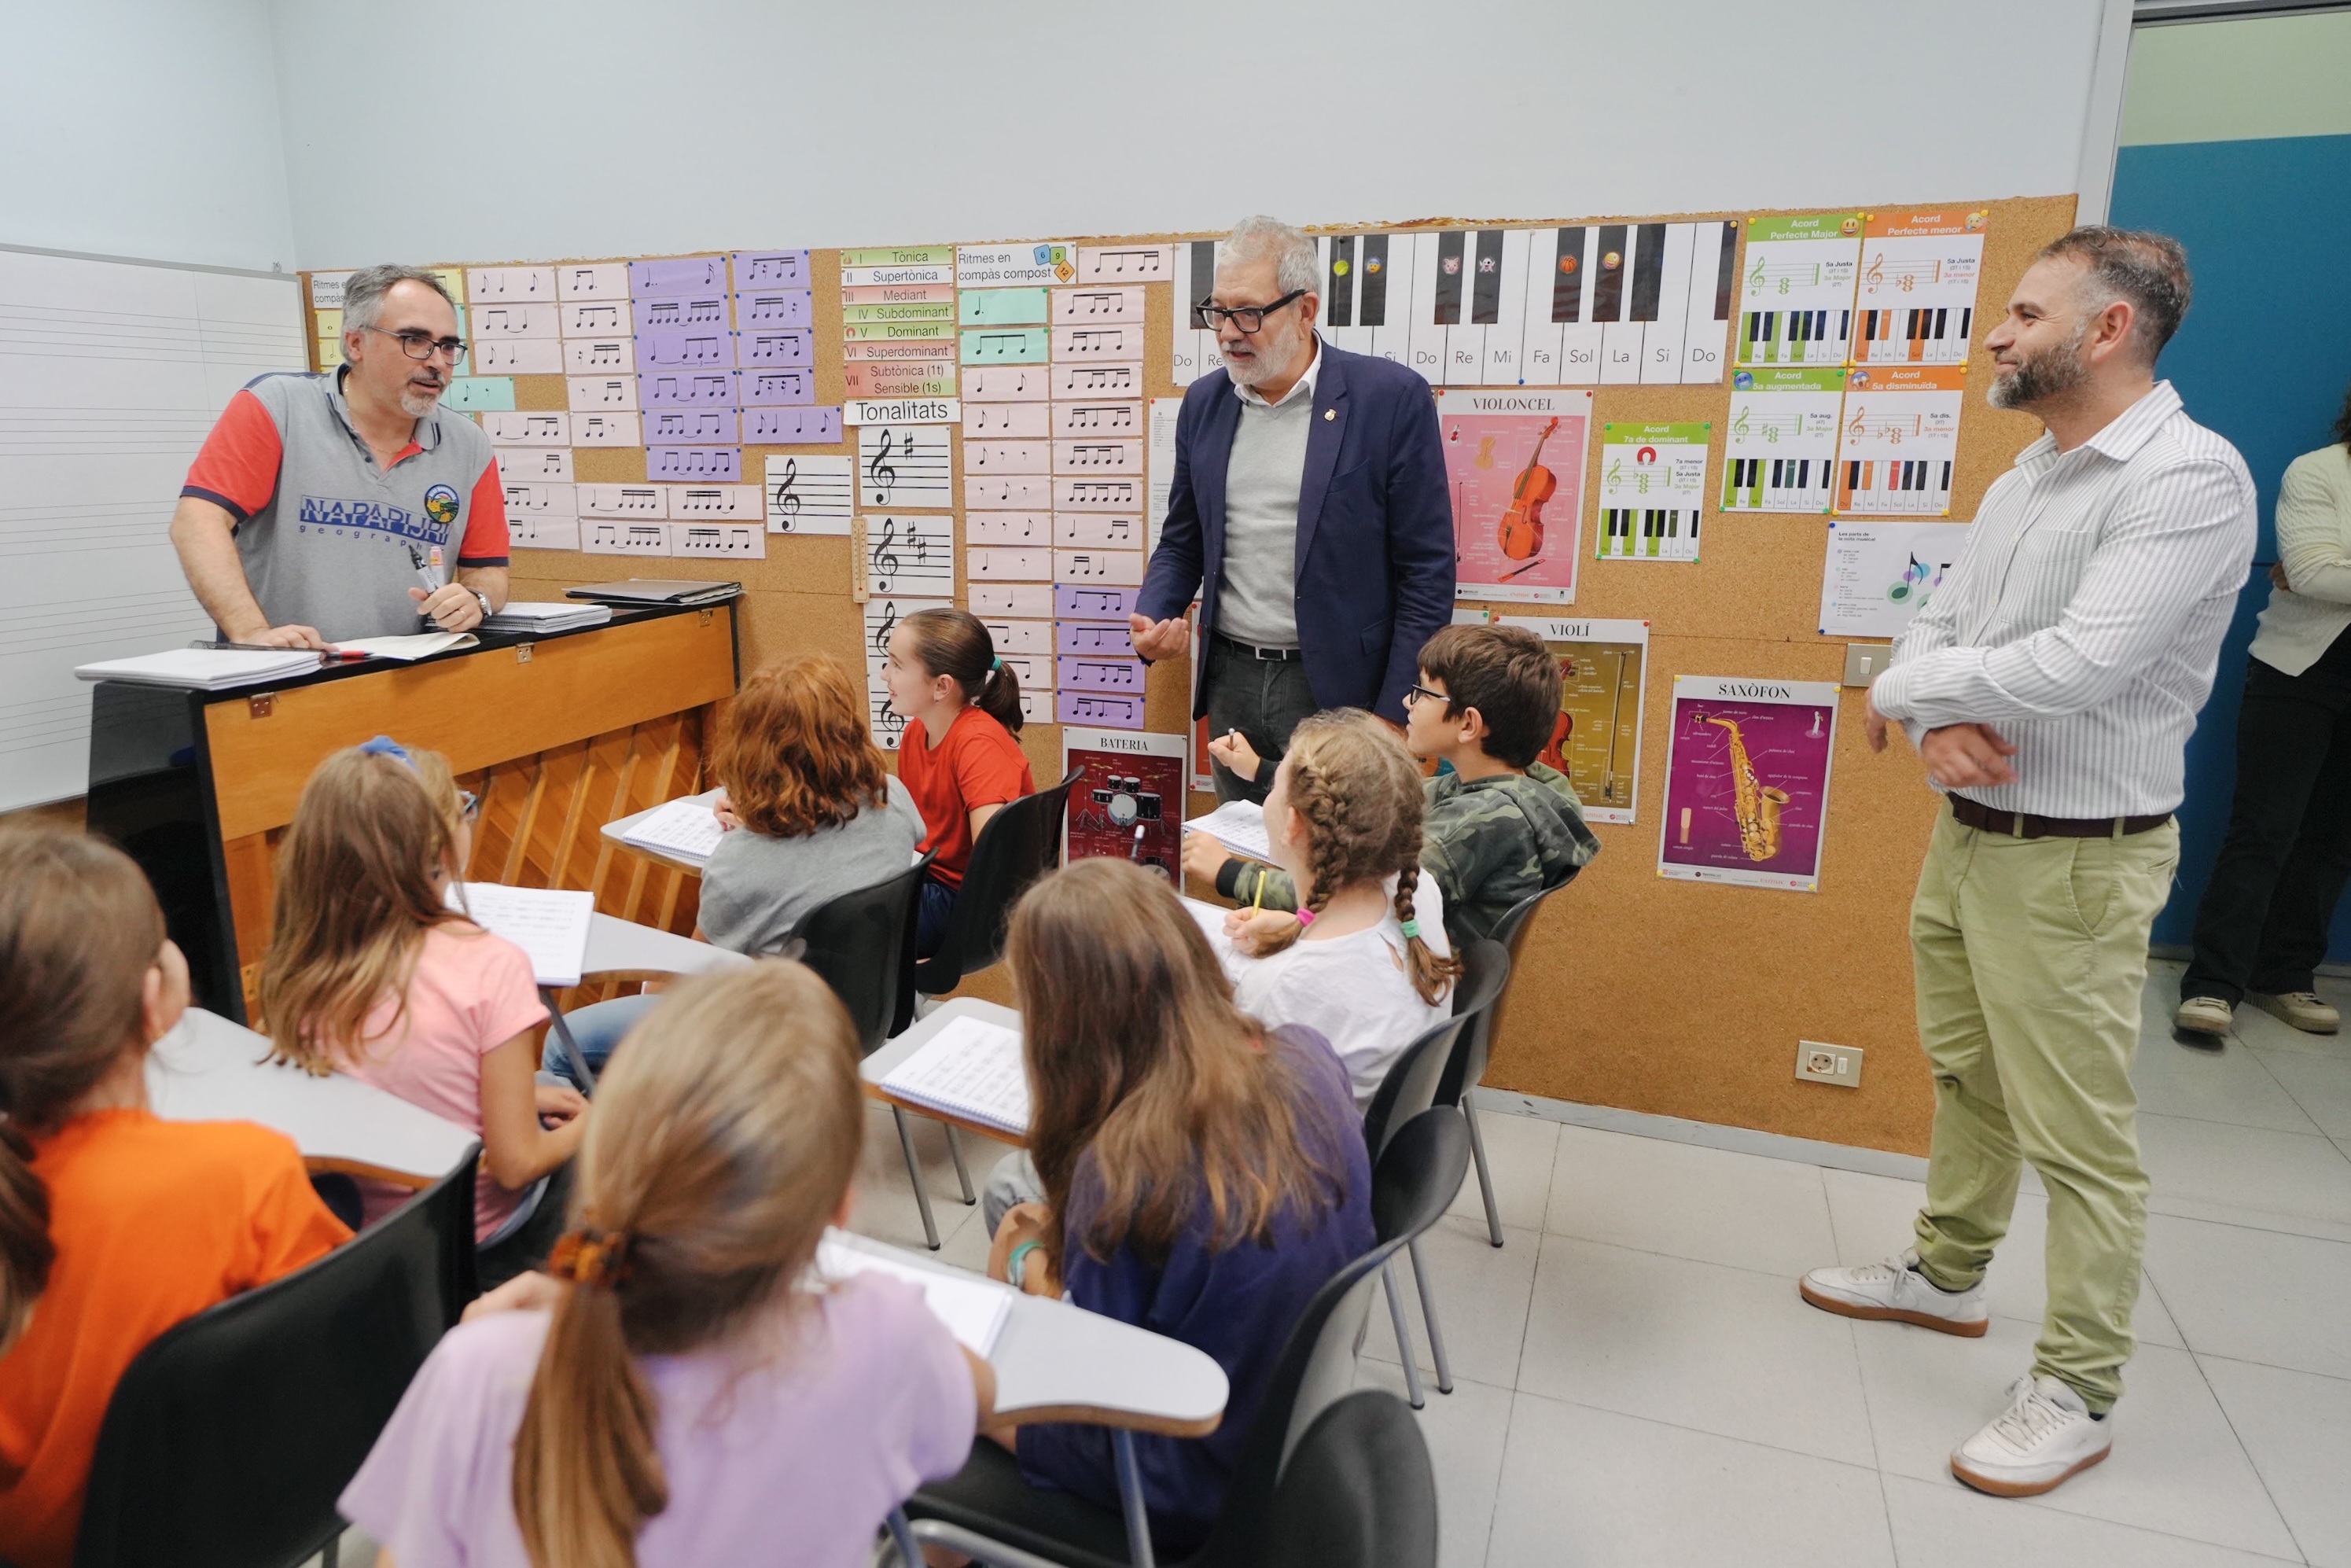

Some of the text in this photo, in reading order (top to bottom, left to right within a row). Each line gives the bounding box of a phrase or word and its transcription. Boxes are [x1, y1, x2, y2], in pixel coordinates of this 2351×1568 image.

[1911, 215, 1941, 223] Acord
[1812, 230, 1838, 239] Major
[1887, 227, 1928, 236] Perfecte
[859, 251, 929, 264] I Tònica
[958, 253, 1011, 263] Ritmes en
[847, 269, 938, 284] II Supertònica
[958, 268, 1051, 282] compàs compost
[1061, 267, 1069, 277] 12
[314, 280, 344, 289] Ritmes
[315, 293, 344, 304] compàs
[844, 290, 926, 302] III Mediant
[859, 307, 948, 319] IV Subdominant
[860, 326, 939, 337] V Dominant
[847, 345, 947, 359] VI Superdominant
[1416, 352, 1437, 364] Do
[1455, 352, 1473, 363] Re
[1494, 351, 1512, 363] Mi
[1533, 351, 1550, 363] Fa
[1569, 349, 1593, 363] Sol
[1613, 349, 1629, 363] La
[1656, 348, 1669, 362] Si
[1692, 348, 1716, 362] Do
[1173, 355, 1223, 366] Do Re
[870, 364, 944, 377] Subtònica (1t)
[845, 376, 859, 386] VII
[874, 382, 941, 395] Sensible (1s)
[1473, 398, 1555, 410] VIOLONCEL
[855, 400, 947, 421] Tonalitats
[301, 499, 451, 544] NAPAPIJRI
[300, 525, 444, 551] geograph
[1550, 623, 1590, 636] VIOLÍ
[1718, 683, 1792, 698] SAXÒFON
[1100, 738, 1149, 751] BATERIA
